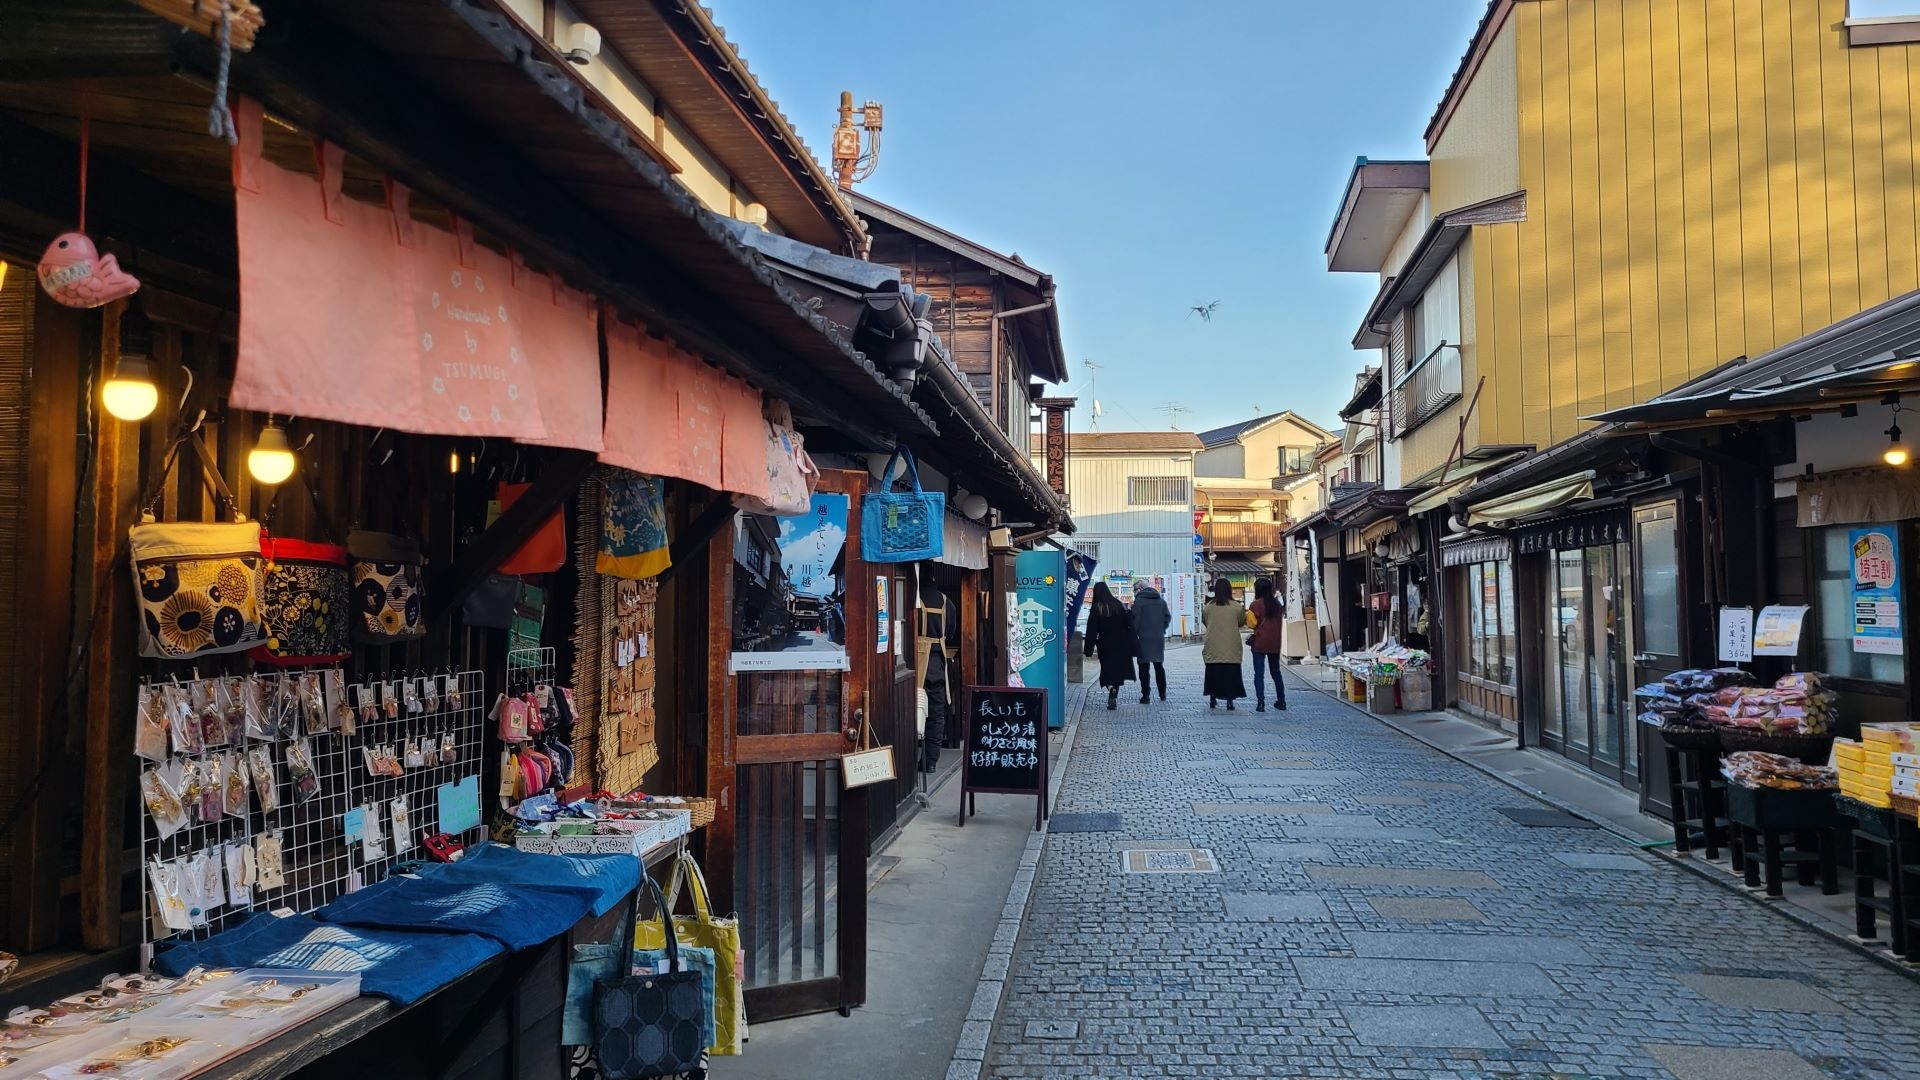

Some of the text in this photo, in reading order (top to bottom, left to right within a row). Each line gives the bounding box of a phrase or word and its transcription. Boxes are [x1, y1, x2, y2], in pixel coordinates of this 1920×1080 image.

[442, 362, 507, 382] TSUMUGI
[801, 564, 811, 587] 川越
[1860, 557, 1891, 580] 埼玉割
[1017, 576, 1042, 586] LOVE
[978, 699, 1027, 717] 長いも
[971, 750, 1039, 770] 好評販売中
